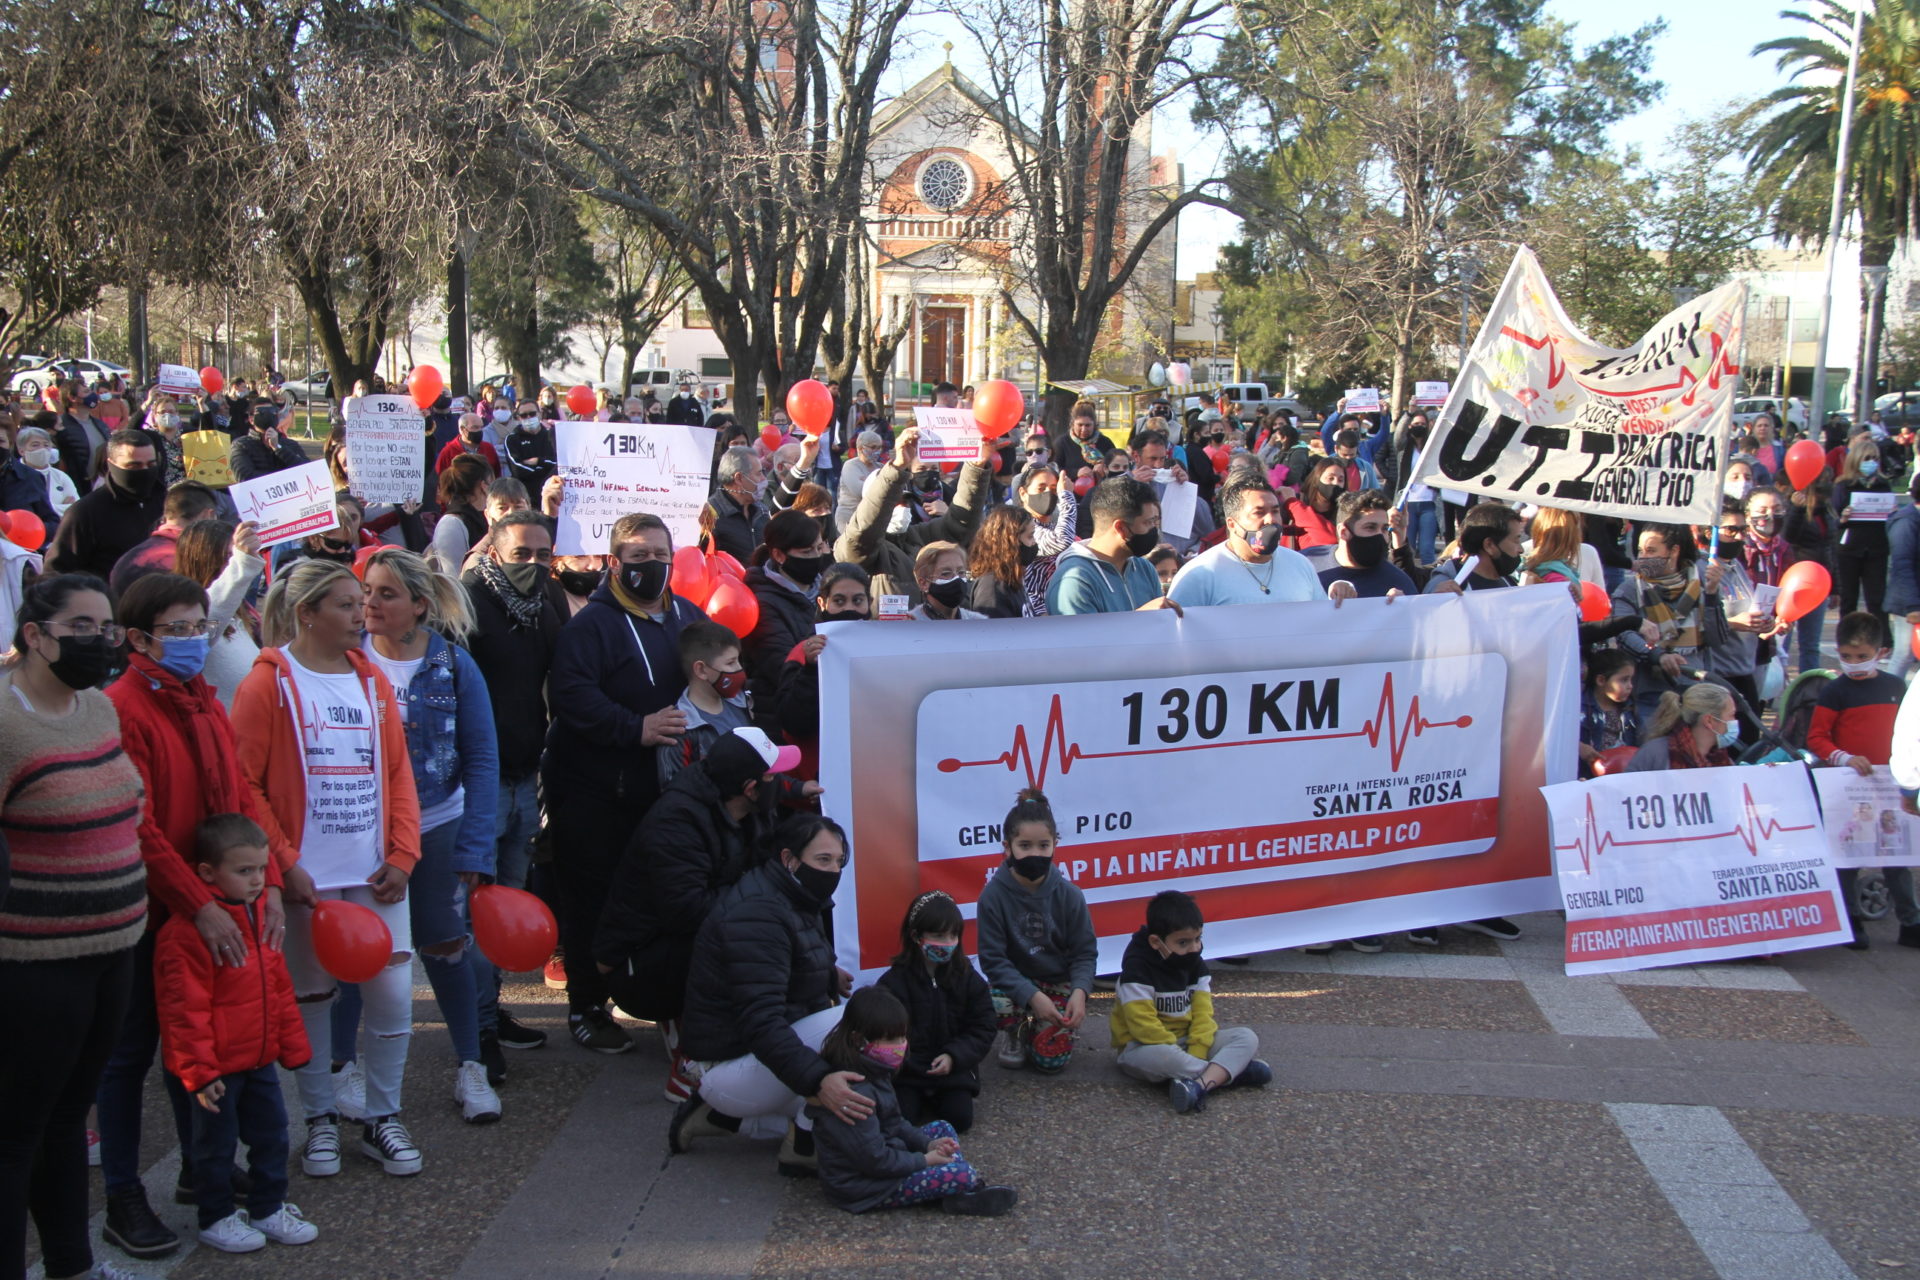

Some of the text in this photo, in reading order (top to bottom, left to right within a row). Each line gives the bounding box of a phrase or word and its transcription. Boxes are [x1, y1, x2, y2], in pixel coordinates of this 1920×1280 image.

[265, 480, 300, 500] 130 KM
[327, 706, 346, 723] 130
[347, 707, 364, 725] KM
[1122, 677, 1340, 746] 130 KM
[321, 780, 374, 793] Por los que ESTA
[1305, 767, 1468, 796] TERAPIA INTENSIVA PEDIATRICA
[312, 809, 325, 821] Por
[325, 809, 339, 820] mis
[339, 809, 356, 822] hijos
[320, 797, 331, 808] por
[332, 795, 343, 806] los
[344, 797, 357, 808] que
[1076, 780, 1463, 834] PICO SANTA ROSA
[1621, 791, 1714, 830] 130 KM
[321, 823, 334, 834] UTI
[1566, 857, 1825, 910] GENERAL PICO TERAPIA INTESIVA PEDIATRICA
[1717, 869, 1820, 901] SANTA ROSA
[1571, 904, 1823, 953] #TERAPIAINFANTILGENERALPICO
